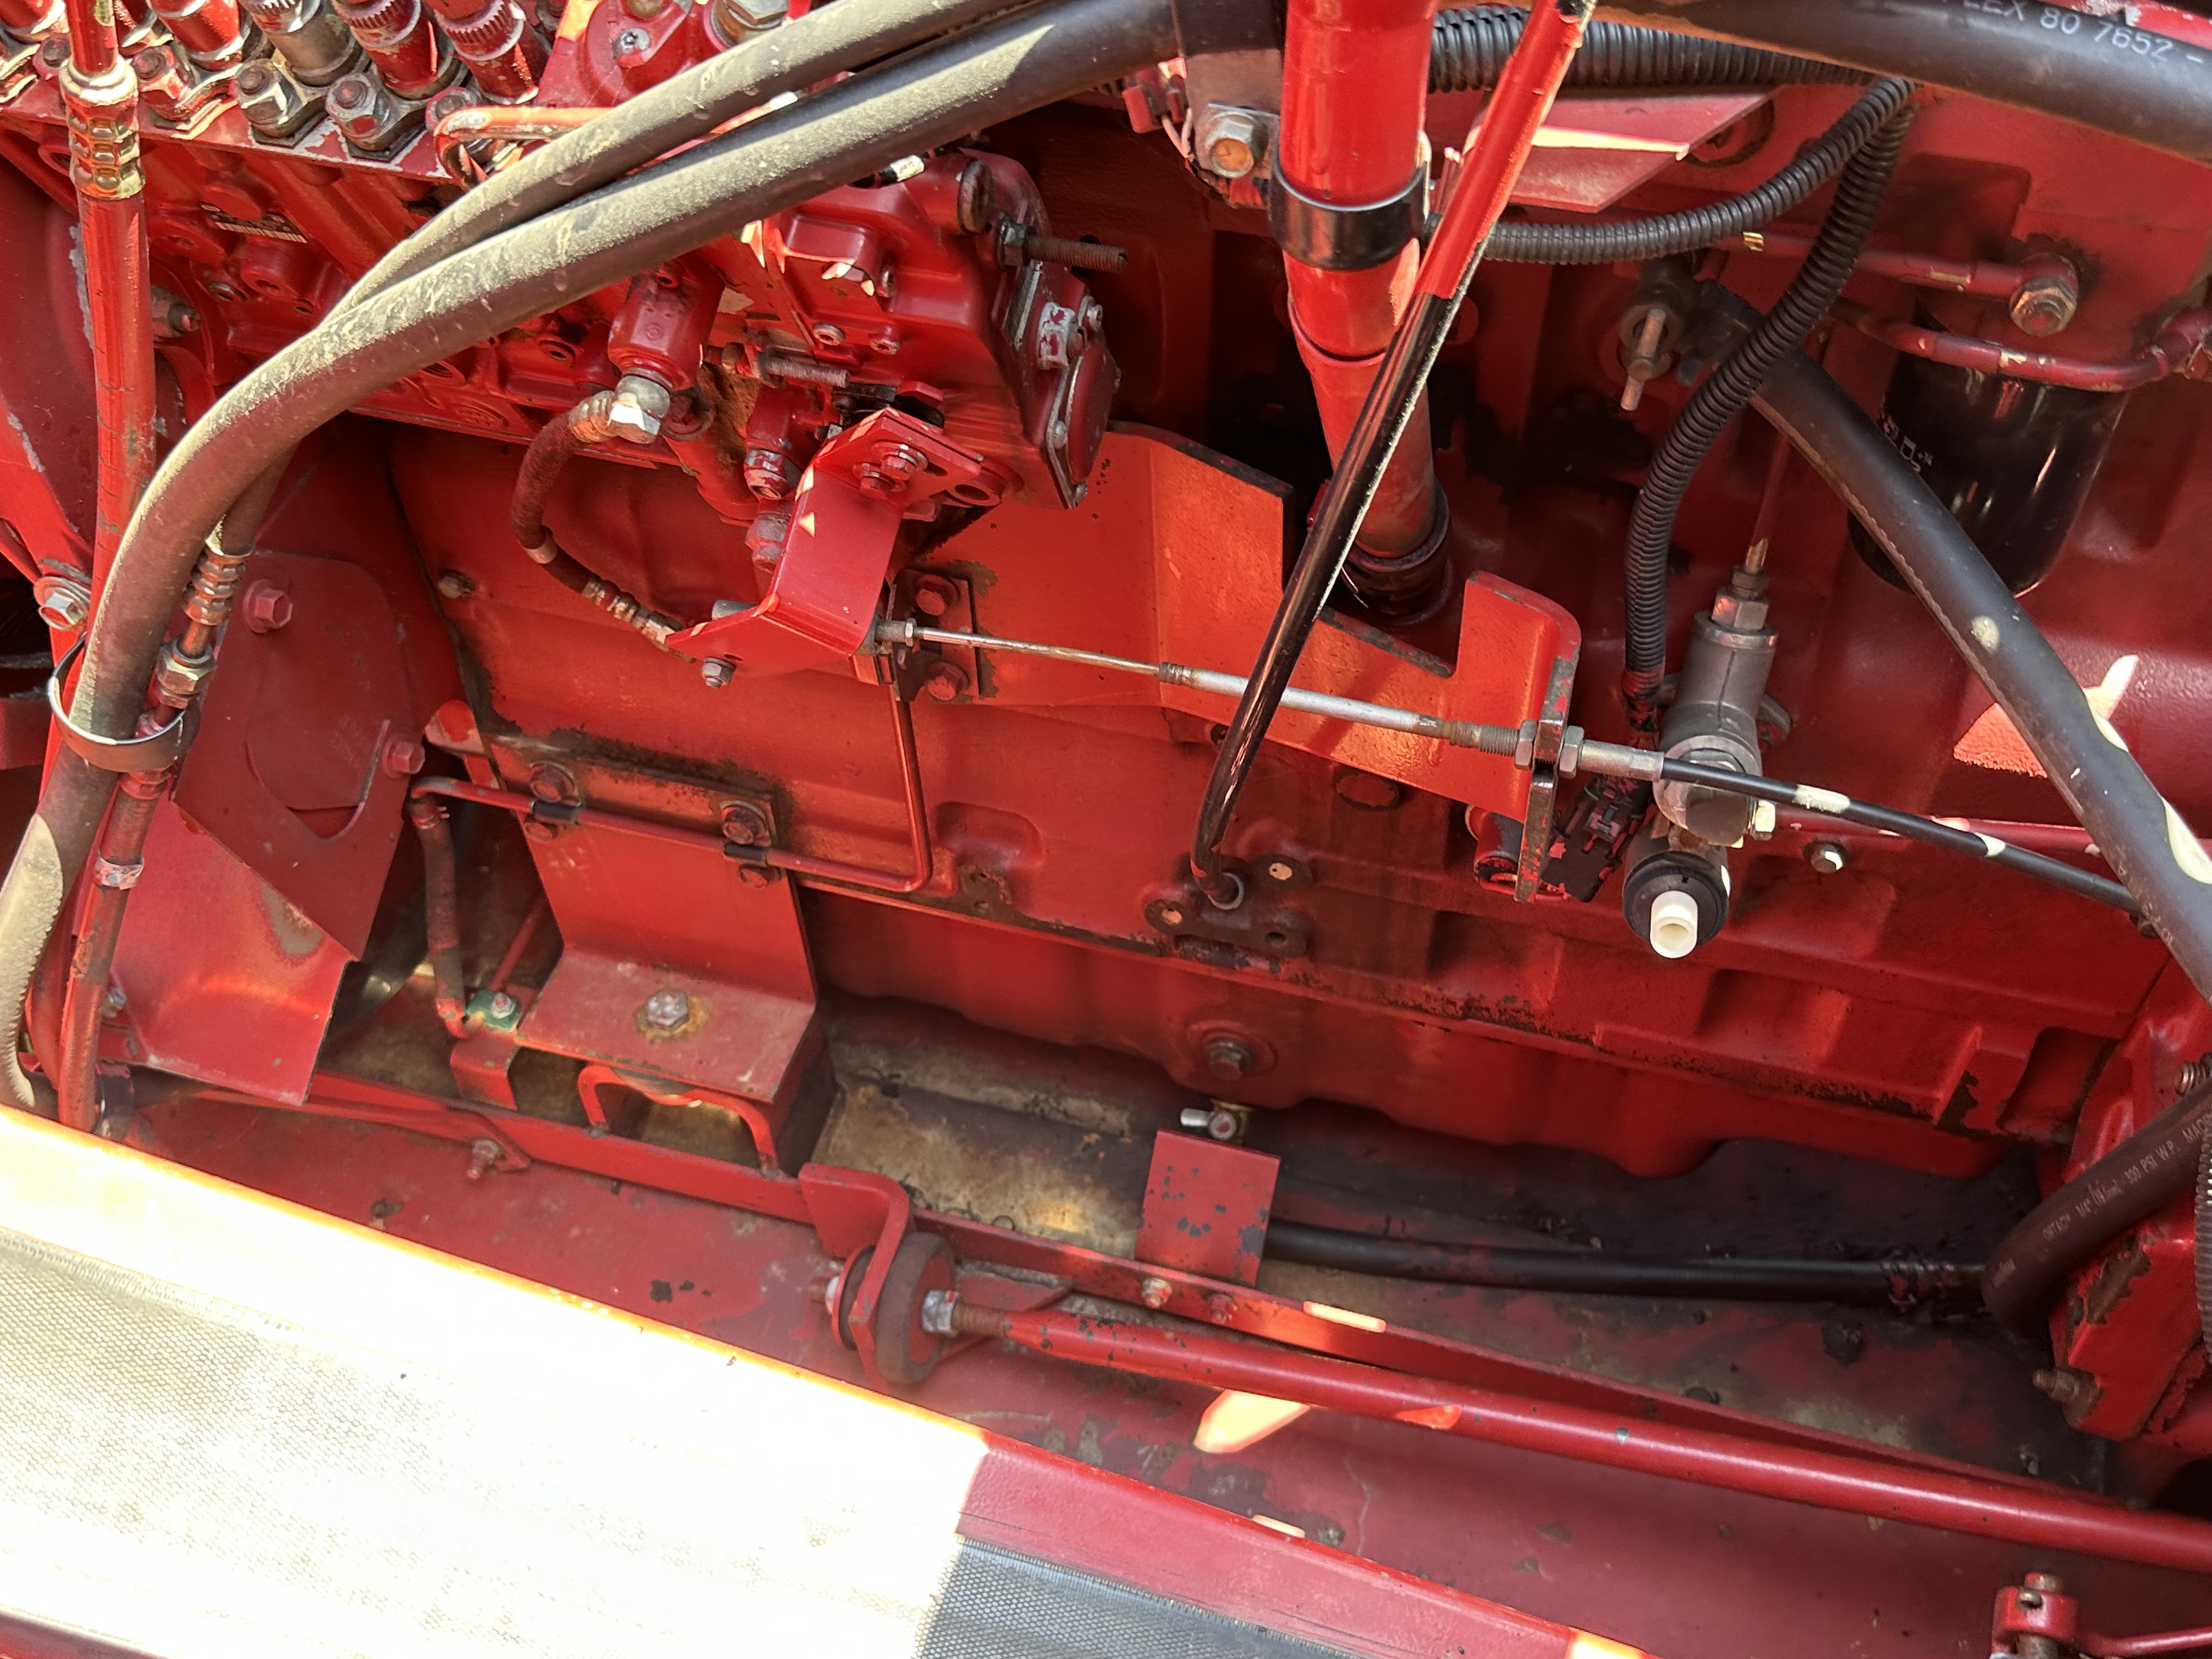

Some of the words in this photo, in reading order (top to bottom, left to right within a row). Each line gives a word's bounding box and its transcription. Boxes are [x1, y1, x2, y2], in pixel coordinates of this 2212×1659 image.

[2040, 7, 2080, 34] 80
[2094, 20, 2174, 61] 7652
[2140, 1154, 2158, 1174] PSI
[2181, 1118, 2208, 1144] MAD
